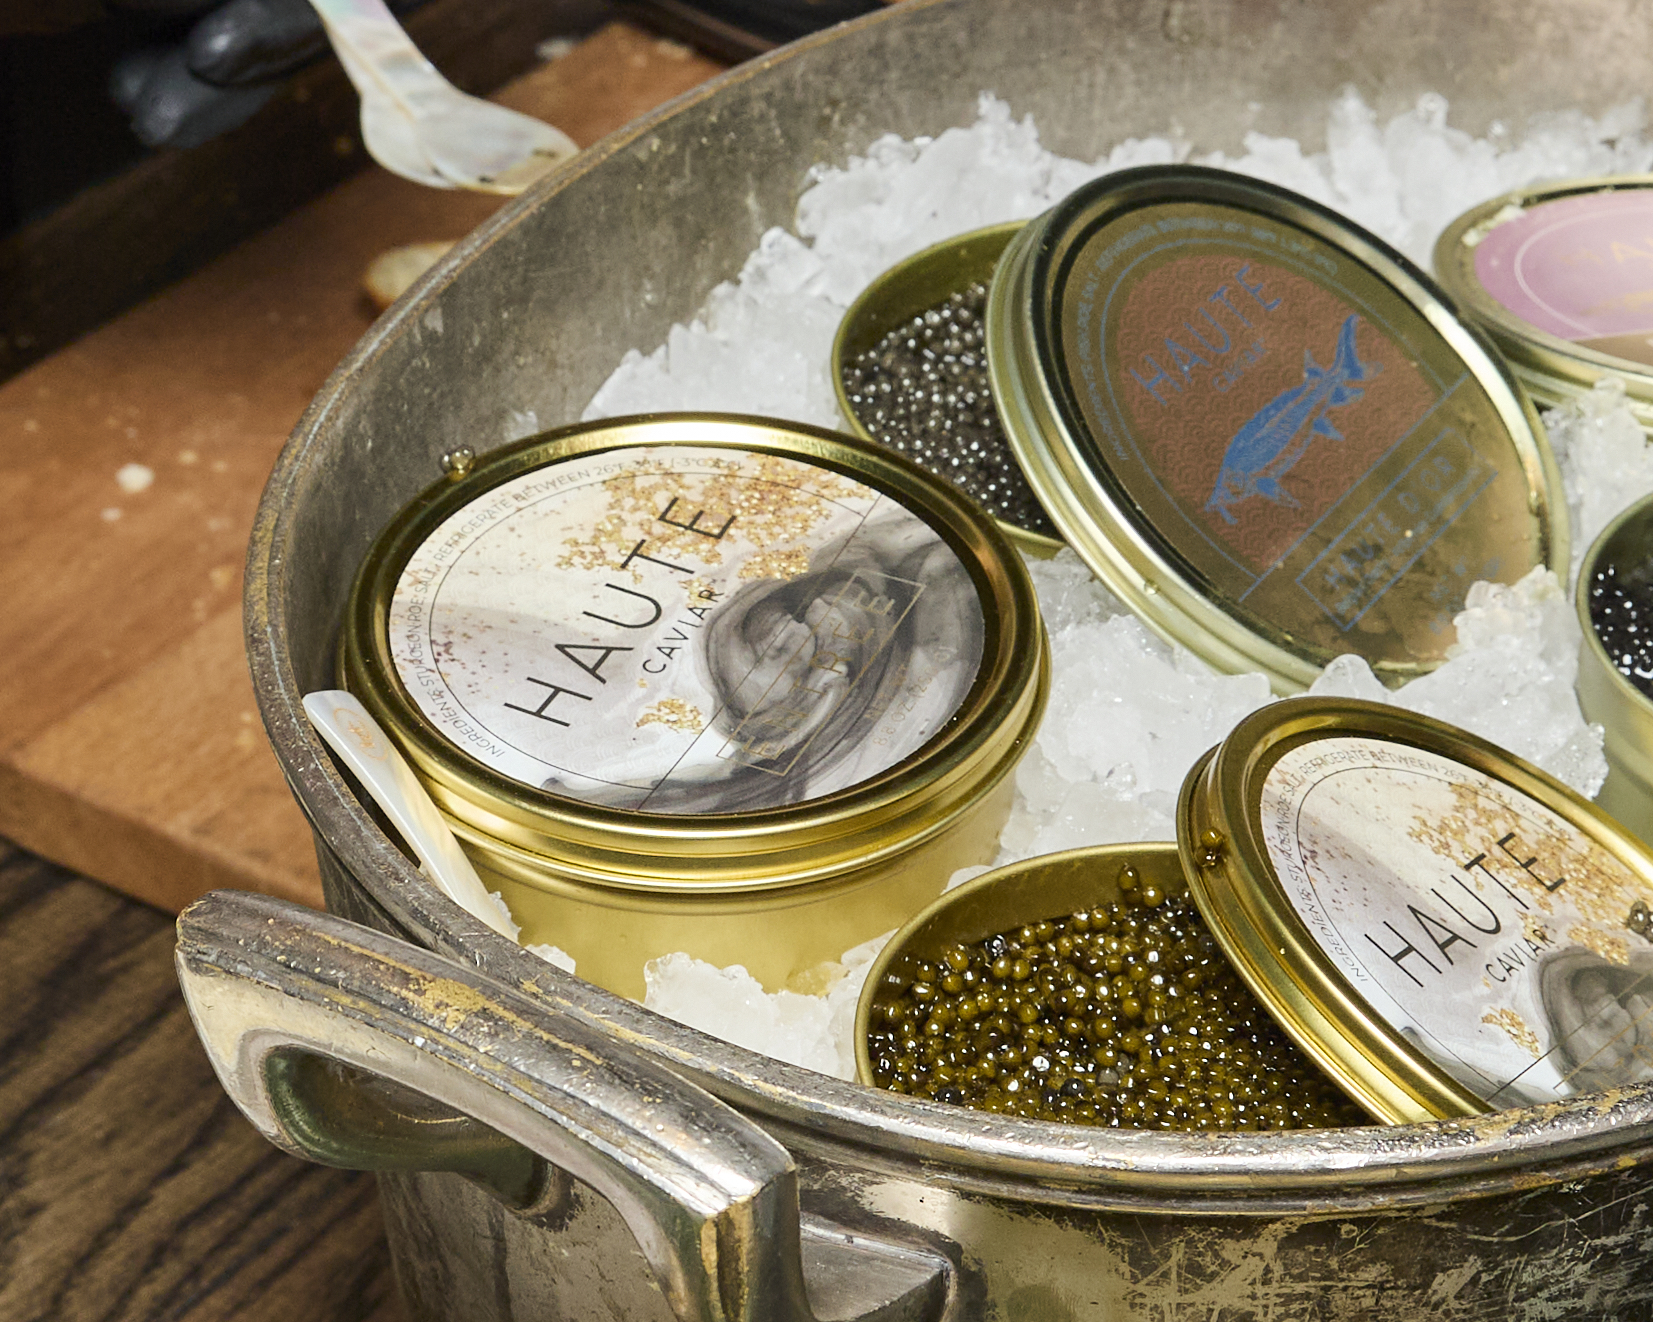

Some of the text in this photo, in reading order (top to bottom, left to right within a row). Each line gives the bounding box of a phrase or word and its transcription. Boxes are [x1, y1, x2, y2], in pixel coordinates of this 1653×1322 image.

[1130, 264, 1282, 406] HAUTE
[502, 497, 737, 728] HAUTE
[1364, 831, 1567, 988] HAUTE
